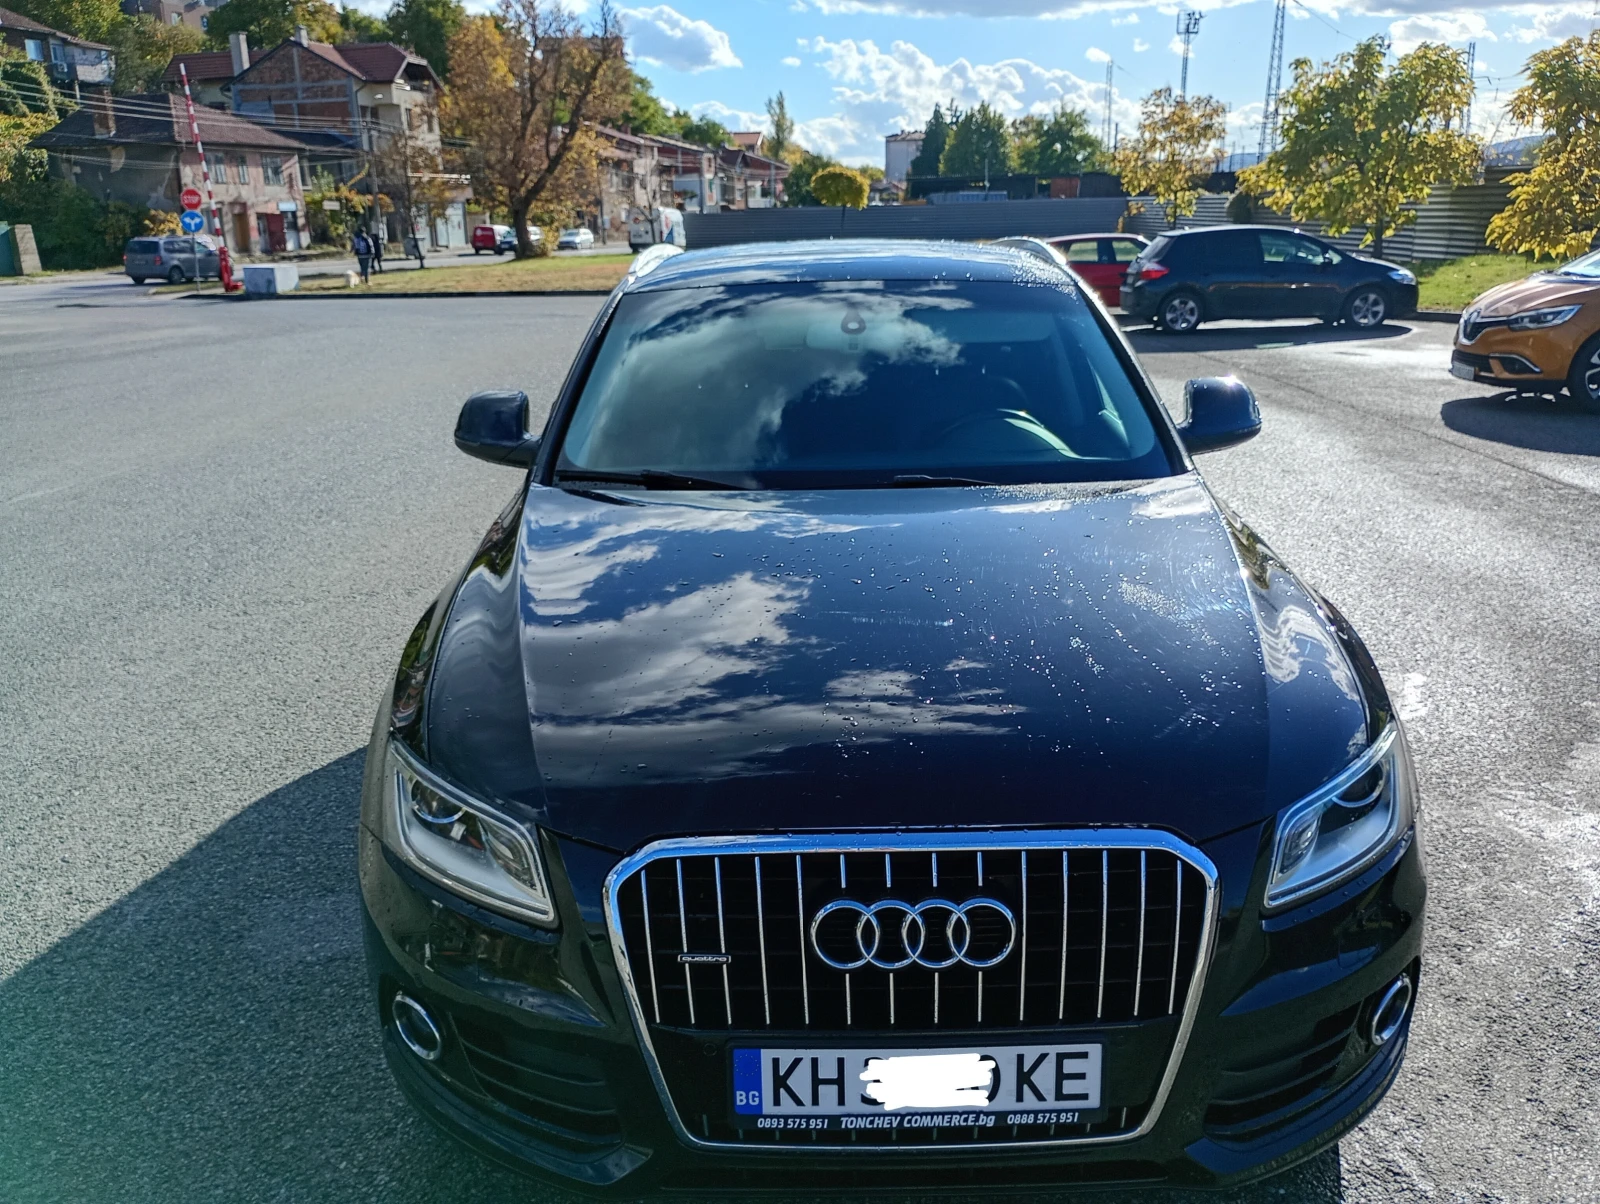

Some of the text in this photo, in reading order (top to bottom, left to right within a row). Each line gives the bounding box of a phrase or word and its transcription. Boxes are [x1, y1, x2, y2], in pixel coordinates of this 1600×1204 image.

[183, 195, 199, 203] STOP
[771, 1056, 846, 1107] KH
[1015, 1051, 1089, 1103] KE
[735, 1090, 760, 1106] BG
[757, 1117, 828, 1129] 0893 575 951
[840, 1113, 996, 1129] TONCHEV COMMERCE.bg
[1007, 1112, 1079, 1125] 0888 575 951
